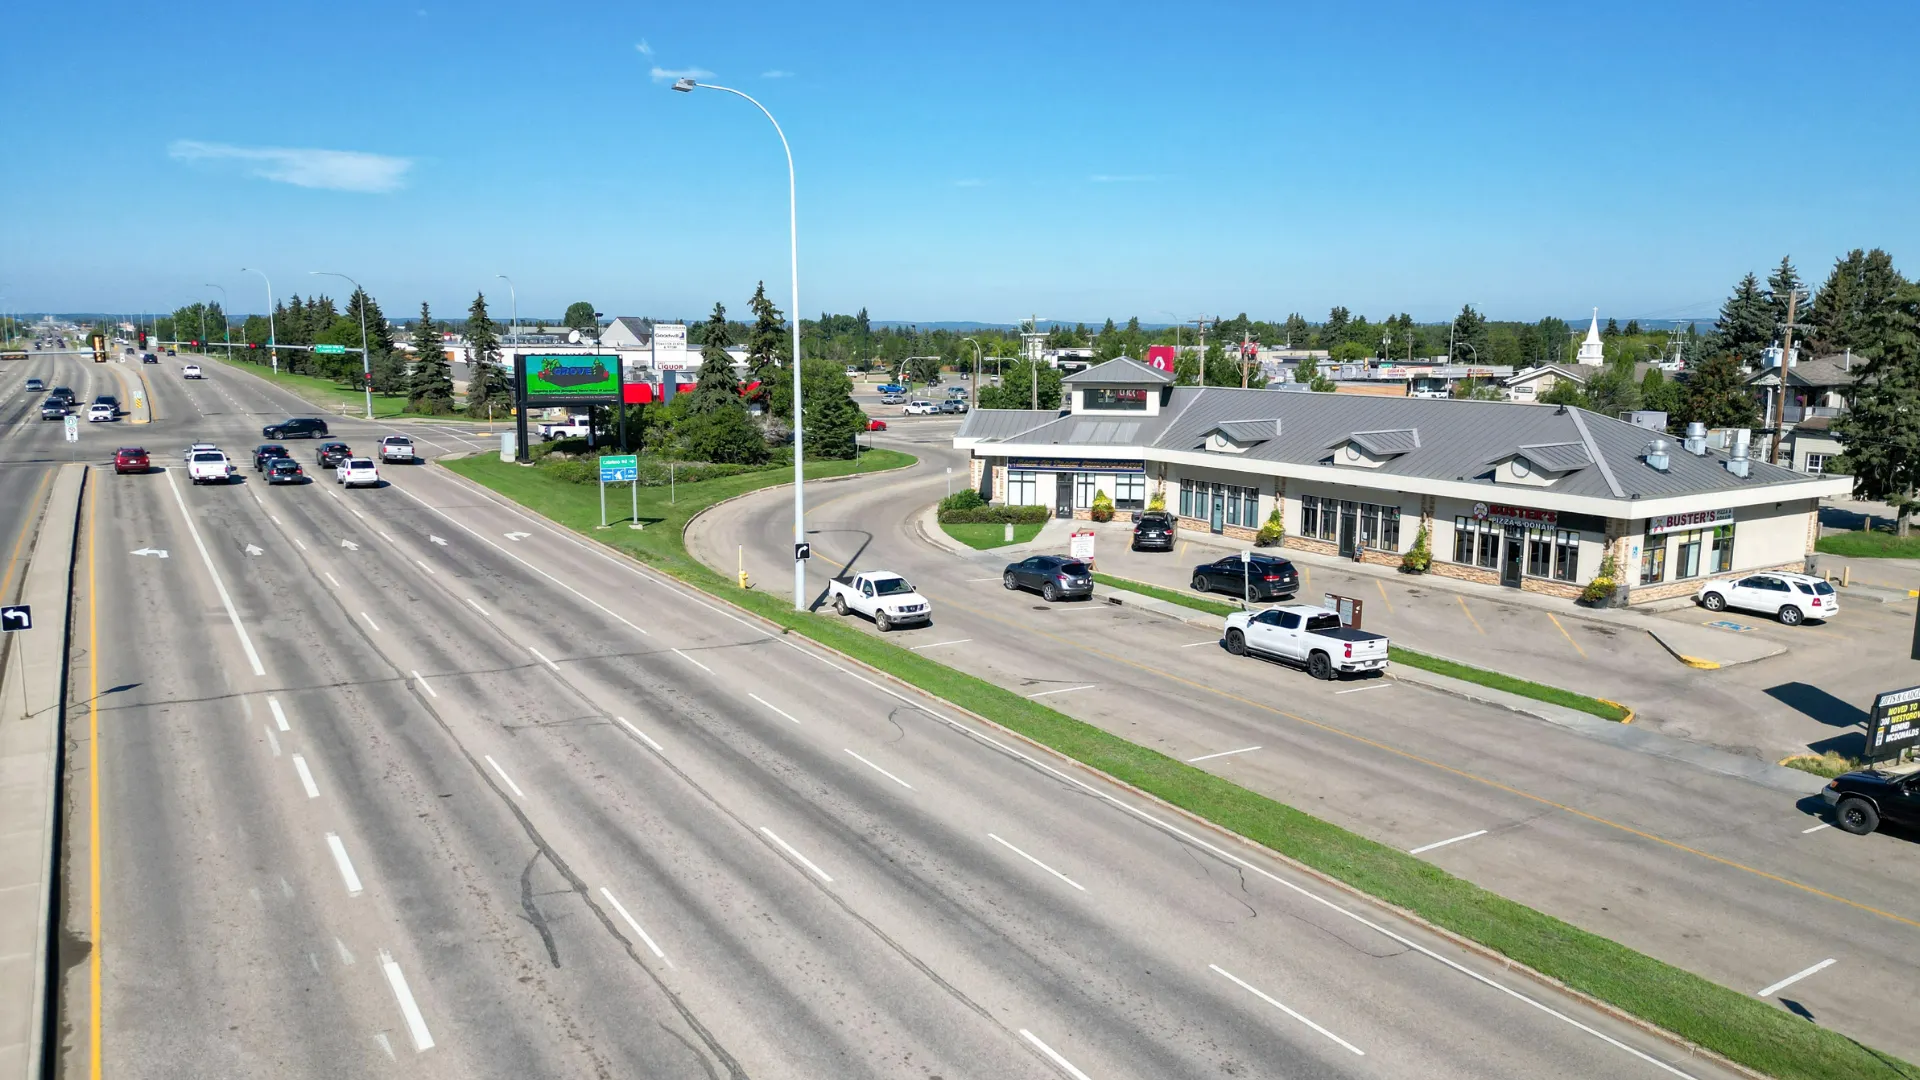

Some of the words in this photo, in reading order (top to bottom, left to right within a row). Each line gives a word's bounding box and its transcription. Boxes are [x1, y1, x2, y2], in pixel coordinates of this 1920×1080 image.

[1490, 505, 1556, 522] BUSTER'S
[1666, 511, 1715, 527] BUSTER'S
[1492, 518, 1514, 526] PIZZA
[1524, 522, 1555, 531] DONAIR
[1888, 705, 1908, 716] MOVED
[1910, 703, 1918, 711] TO
[1890, 722, 1910, 733] BEHIND
[1886, 728, 1919, 742] MCDONALDS
